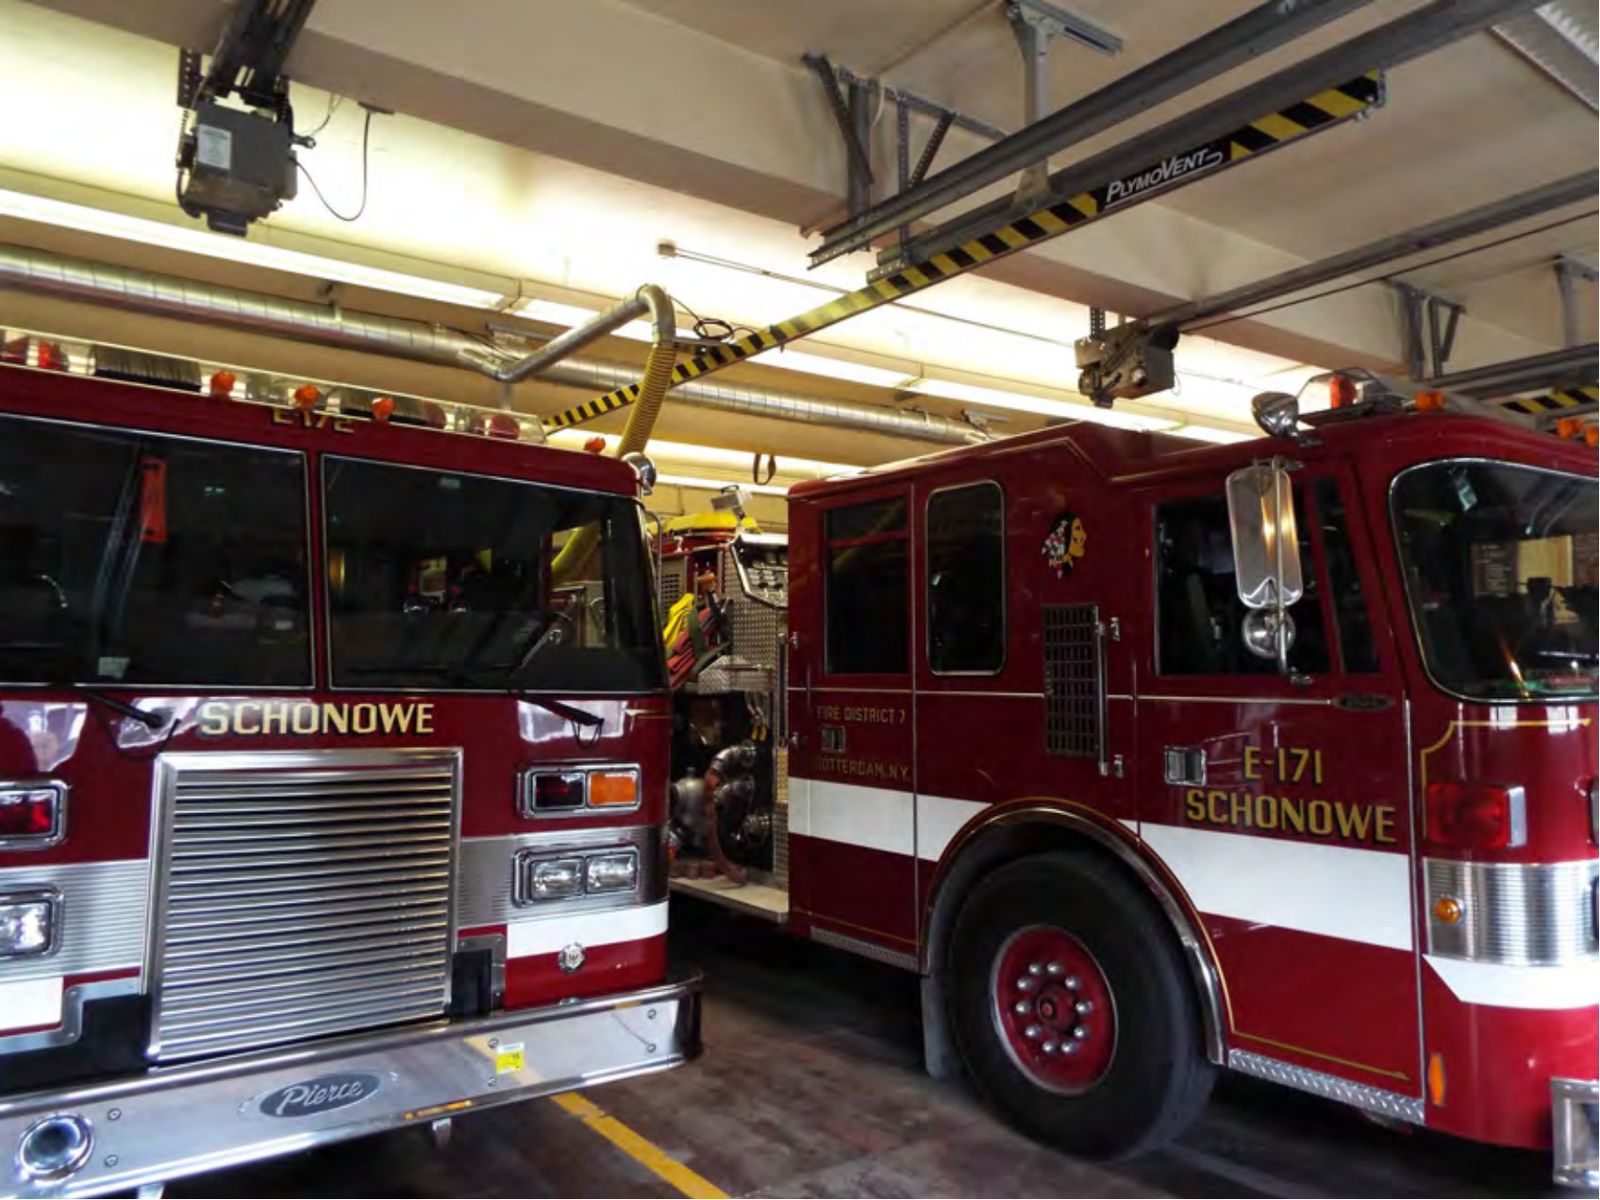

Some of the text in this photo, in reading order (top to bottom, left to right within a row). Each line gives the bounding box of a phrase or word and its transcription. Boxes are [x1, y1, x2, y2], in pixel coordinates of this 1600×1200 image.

[200, 702, 435, 735] SCHONOWE
[816, 706, 841, 721] FIRE
[843, 707, 895, 724] DISTRICT
[1244, 746, 1323, 784] E-171
[1186, 788, 1397, 843] SCHONOWE
[275, 1080, 364, 1116] Pierce
